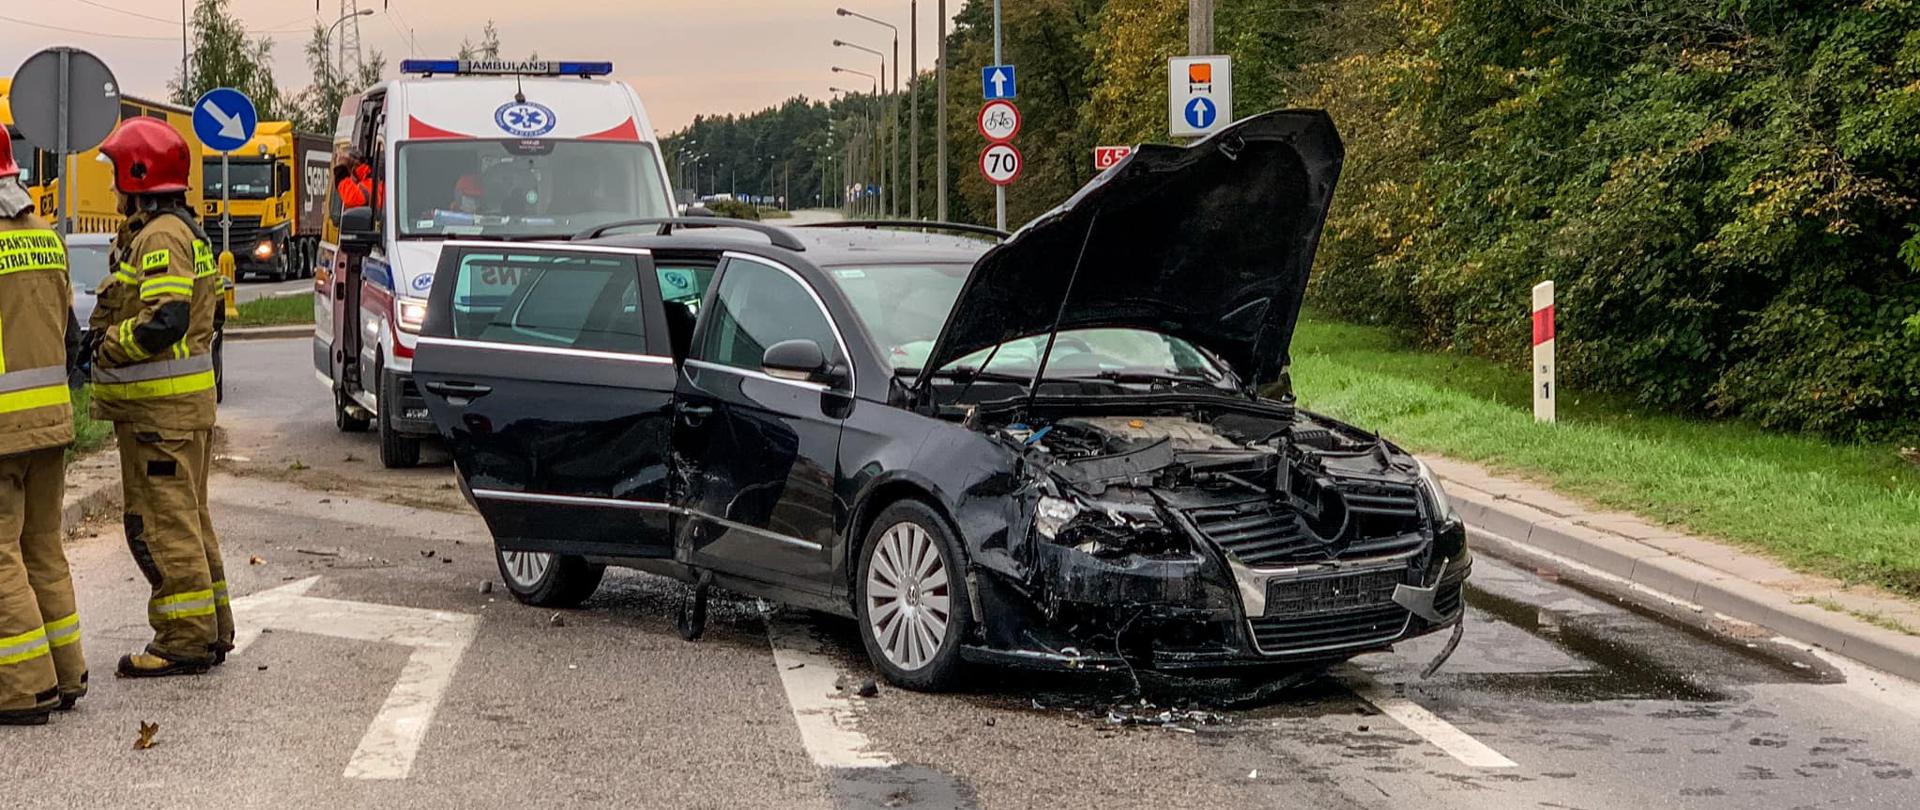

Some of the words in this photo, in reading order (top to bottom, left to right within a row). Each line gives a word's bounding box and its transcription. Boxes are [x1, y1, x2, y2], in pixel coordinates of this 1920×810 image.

[472, 61, 547, 71] AMBULANS
[988, 153, 1016, 173] 70
[1102, 149, 1124, 166] 65
[146, 253, 165, 266] PSP
[1542, 382, 1549, 399] 1
